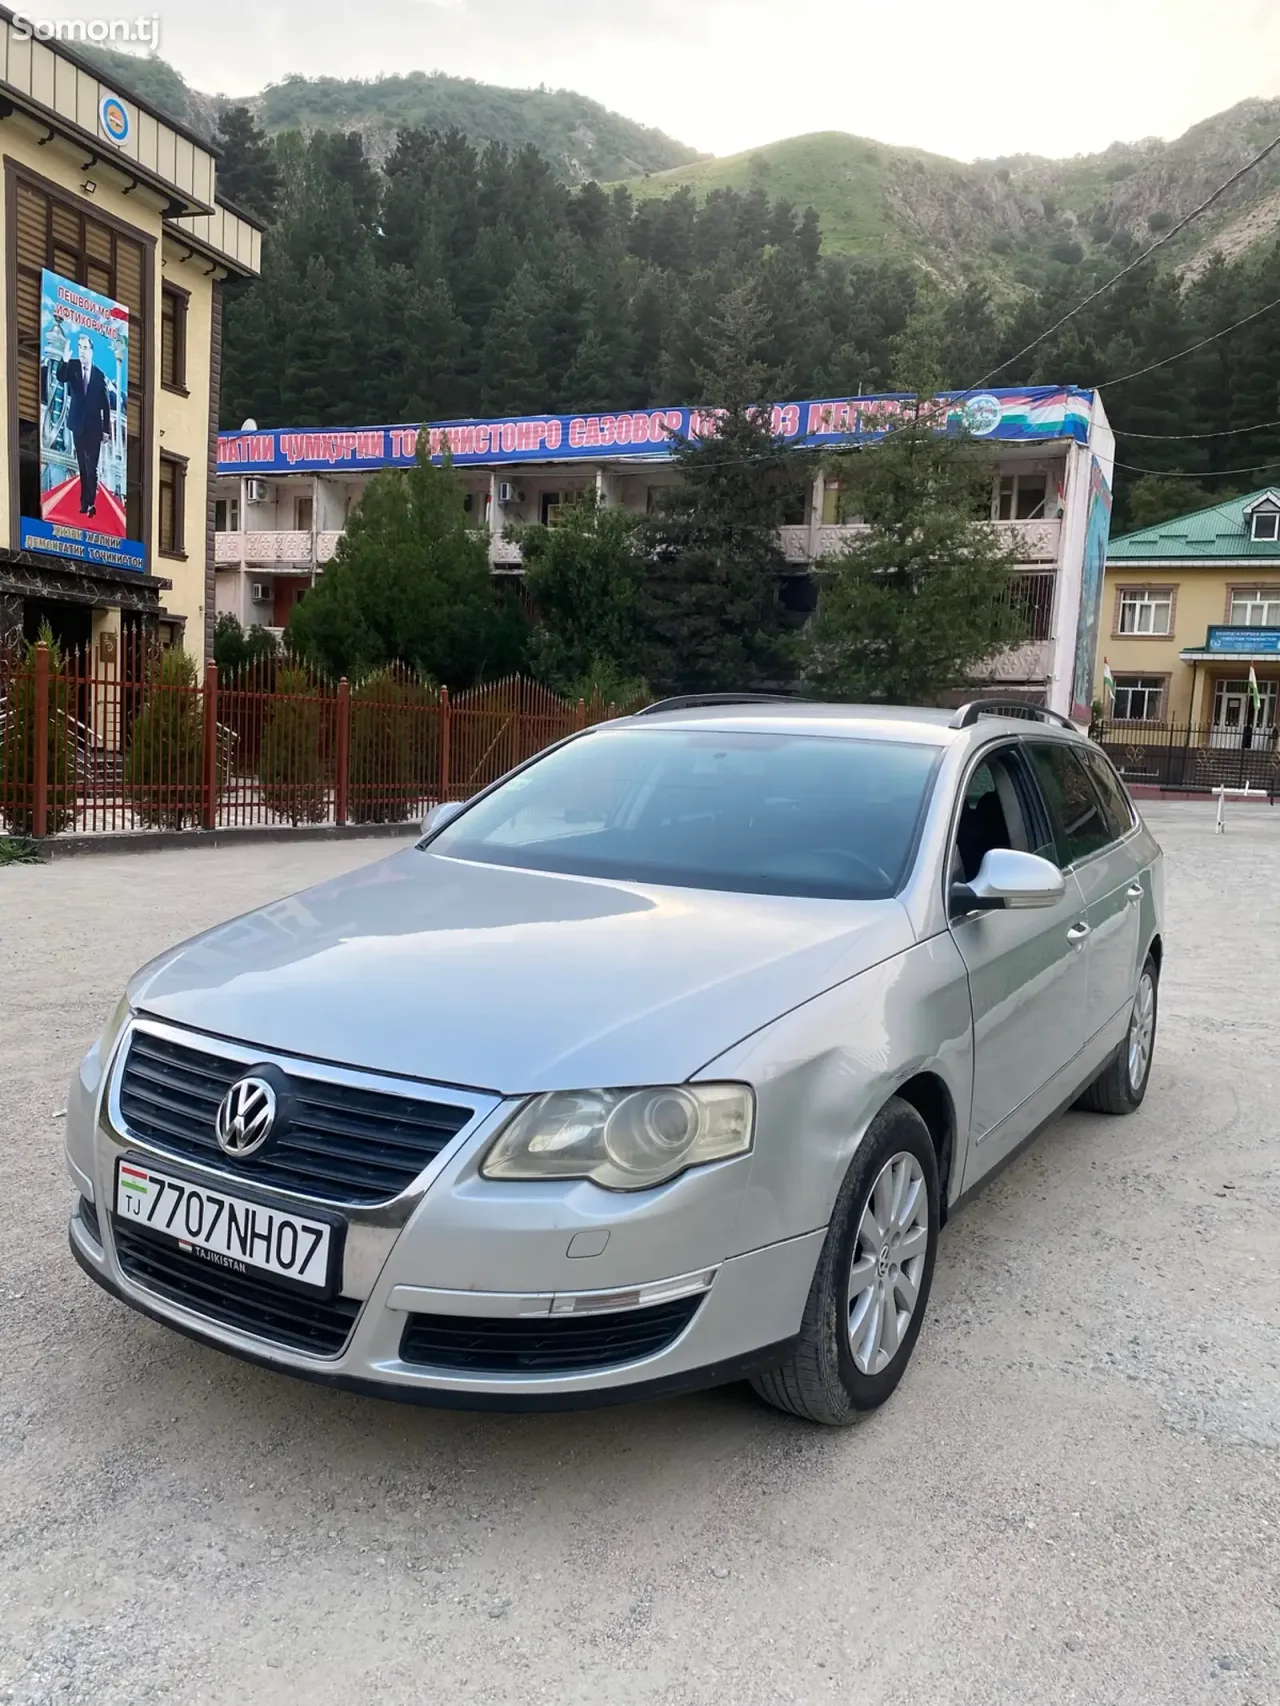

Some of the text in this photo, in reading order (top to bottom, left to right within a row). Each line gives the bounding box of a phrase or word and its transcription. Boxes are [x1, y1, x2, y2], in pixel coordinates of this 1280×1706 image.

[568, 410, 682, 448] САЗОВОР
[126, 1175, 324, 1275] TJ 7707NH07
[195, 1246, 247, 1273] TAJIKISTAN
